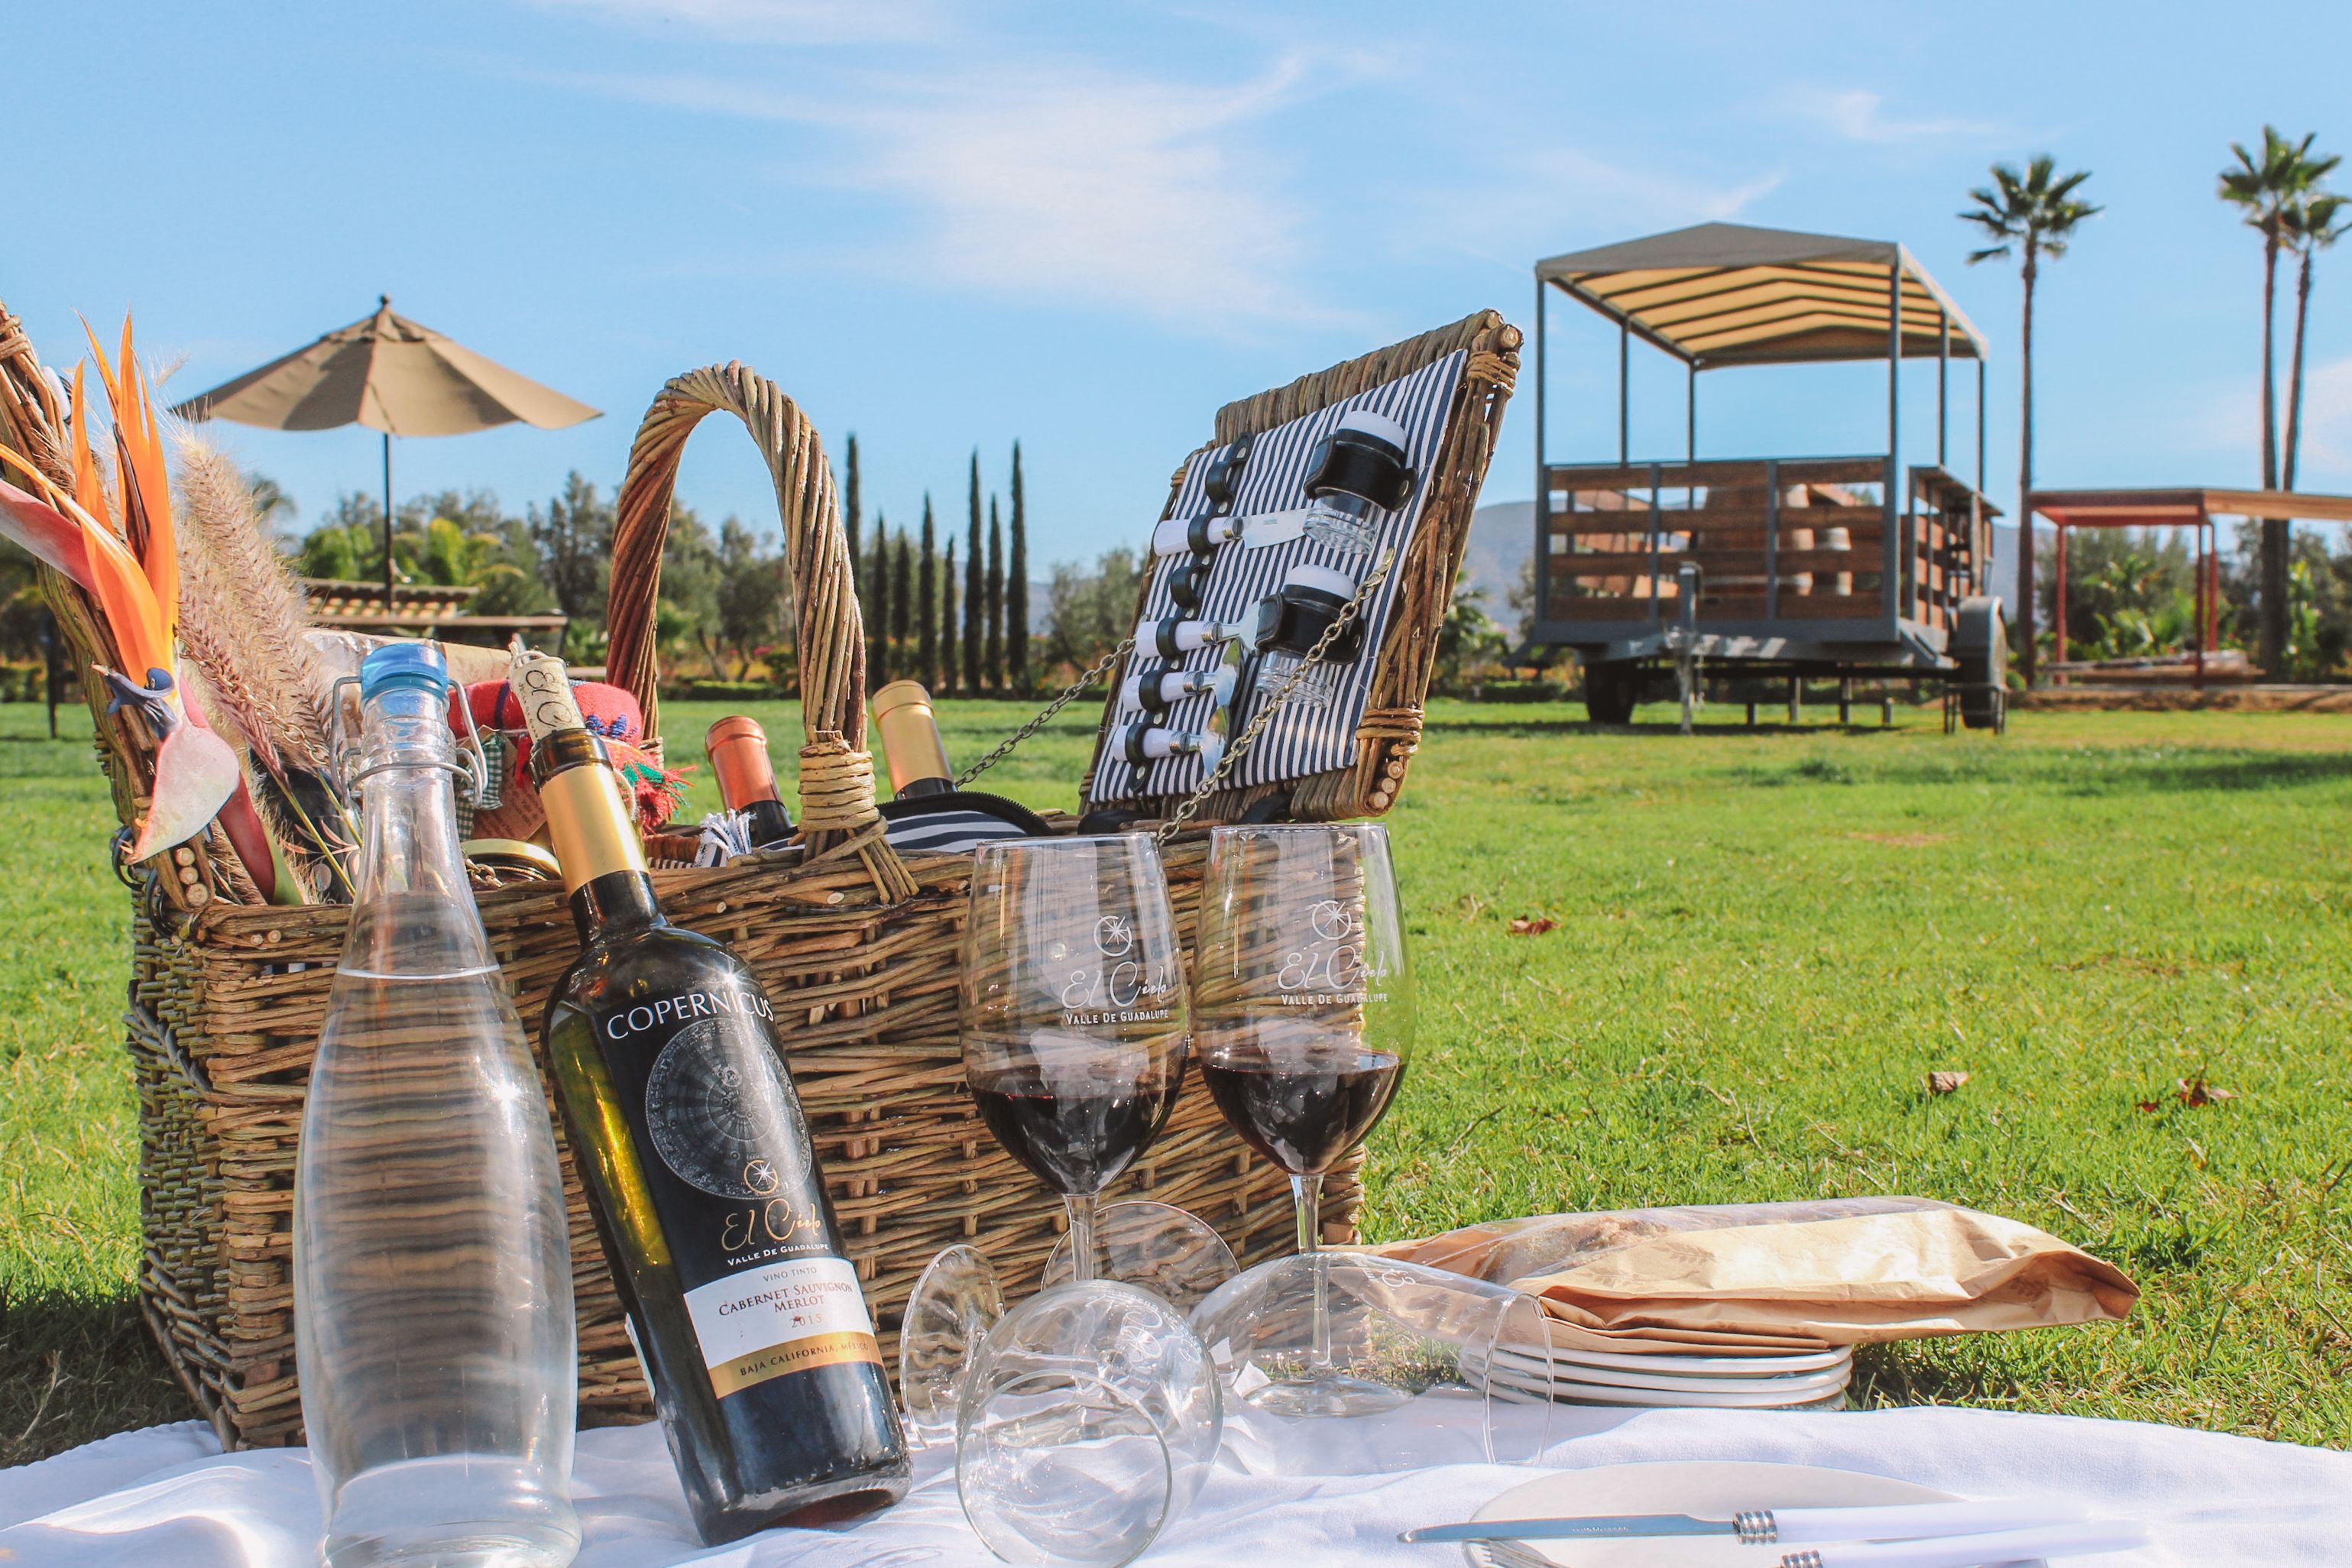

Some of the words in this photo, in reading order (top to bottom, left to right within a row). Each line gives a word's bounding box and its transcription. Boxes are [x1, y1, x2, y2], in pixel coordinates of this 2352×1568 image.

[1278, 952, 1319, 990] El
[1326, 944, 1388, 990] Cielo
[1061, 970, 1102, 1009] El
[1110, 961, 1167, 1007] Cielo
[1281, 994, 1314, 1006] VALLE
[607, 991, 774, 1039] COPERNICUS
[1065, 1013, 1099, 1025] VALLE
[1120, 1009, 1169, 1022] GUADALUPE
[721, 1209, 755, 1251] El
[765, 1198, 821, 1241] Cielo
[727, 1252, 760, 1266] VALLE
[763, 1248, 778, 1257] DE
[780, 1243, 829, 1253] GUADALUPE
[763, 1270, 789, 1282] VINO
[792, 1267, 817, 1277] TINTO
[718, 1288, 789, 1316] CABERNET
[794, 1282, 853, 1296] SAUVIGNON
[774, 1294, 824, 1313] MERLOT
[789, 1314, 823, 1328] 2015
[740, 1360, 766, 1376] BAJA
